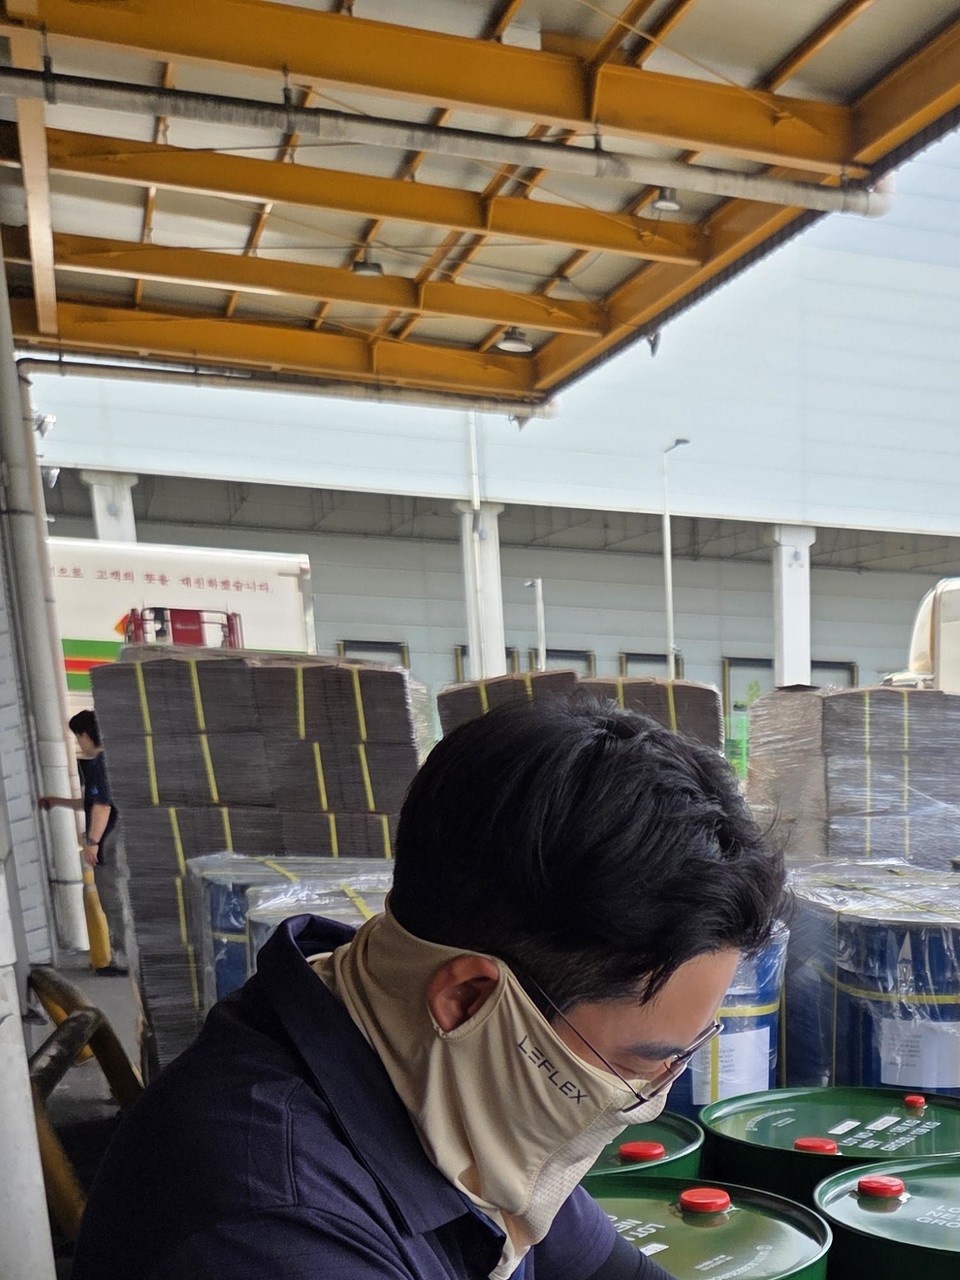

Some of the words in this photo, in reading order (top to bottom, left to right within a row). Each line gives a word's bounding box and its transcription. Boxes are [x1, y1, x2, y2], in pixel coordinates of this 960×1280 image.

[52, 566, 84, 578] 으로
[613, 1218, 643, 1233] NE
[635, 1223, 666, 1239] LOT
